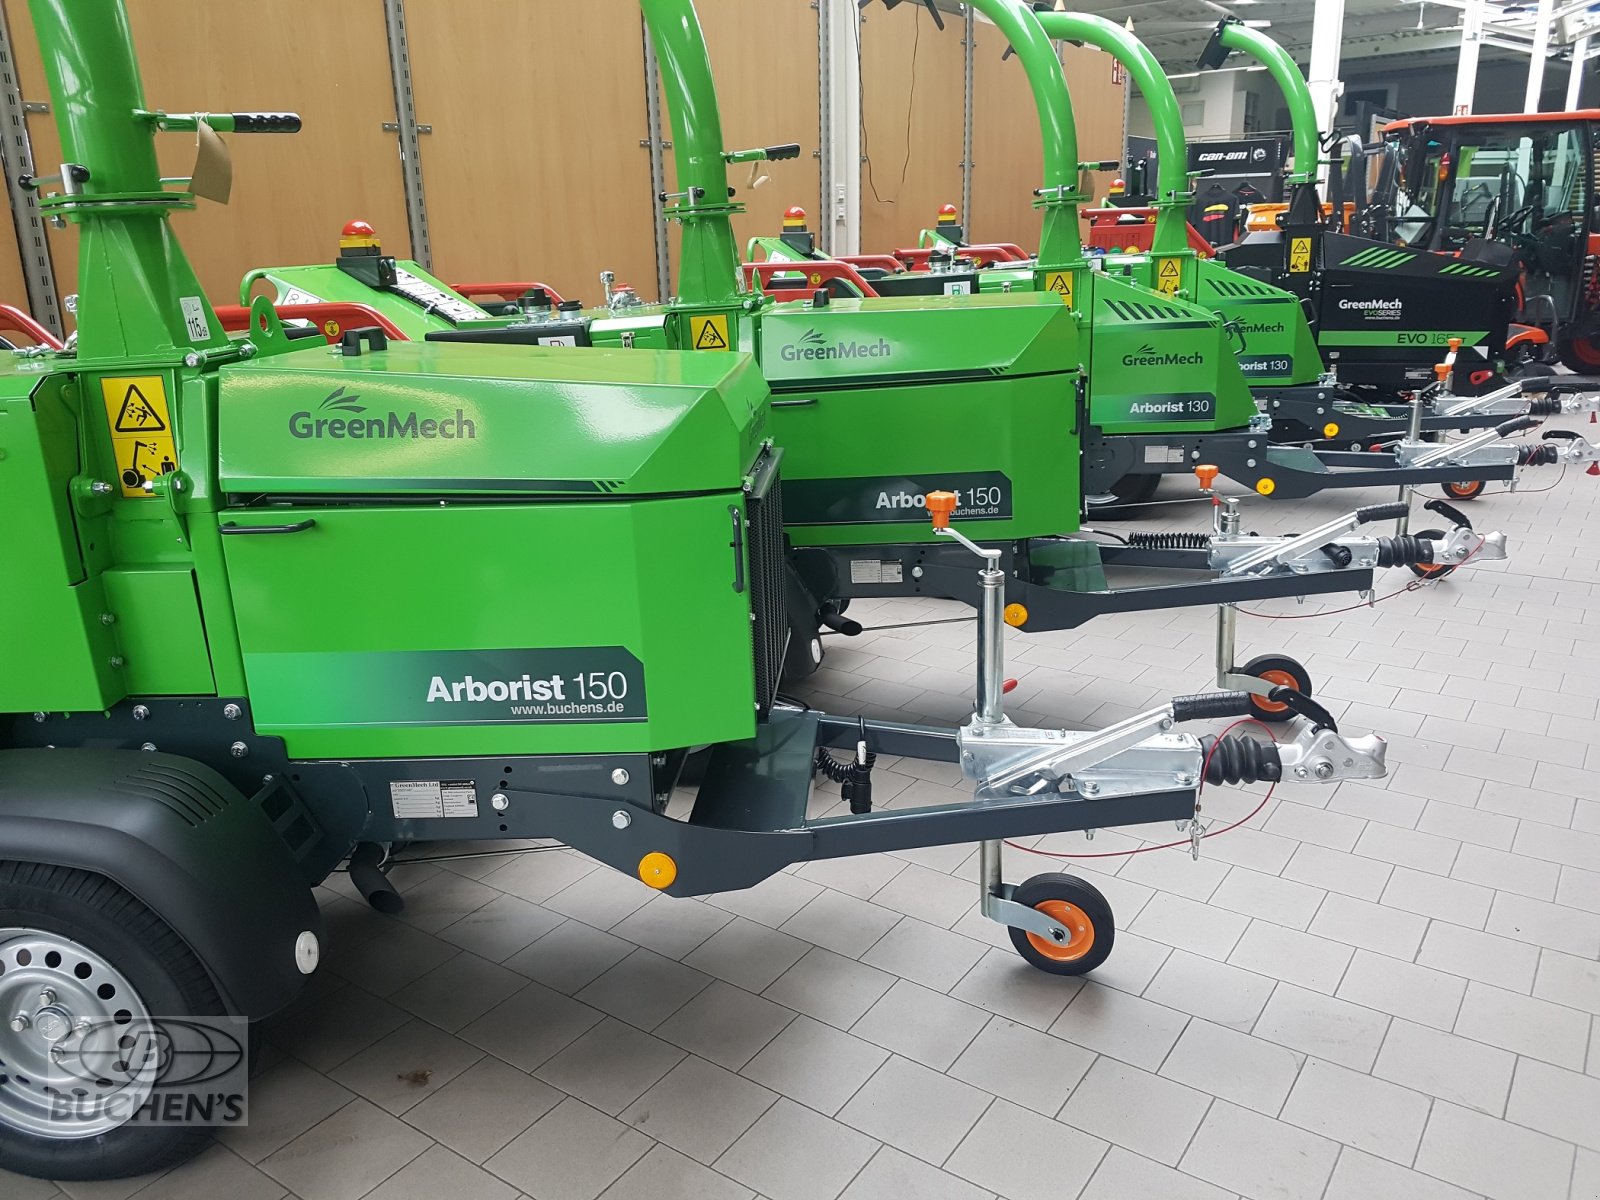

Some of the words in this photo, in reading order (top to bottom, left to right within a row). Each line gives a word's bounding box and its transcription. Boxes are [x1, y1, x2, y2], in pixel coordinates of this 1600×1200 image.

[1198, 151, 1248, 161] can-am
[1338, 298, 1402, 309] GreenMech
[1397, 333, 1428, 344] EVO
[780, 337, 891, 362] GreenMech
[1122, 351, 1204, 367] GreenMech
[1269, 360, 1288, 371] 130
[1129, 401, 1184, 413] Arborist
[1186, 400, 1210, 412] 130
[288, 408, 476, 439] GreenMech
[876, 489, 962, 509] Arbot
[966, 486, 1001, 506] 150
[426, 674, 566, 703] Arborist
[572, 671, 628, 700] 150
[510, 700, 625, 715] www.buchens.de
